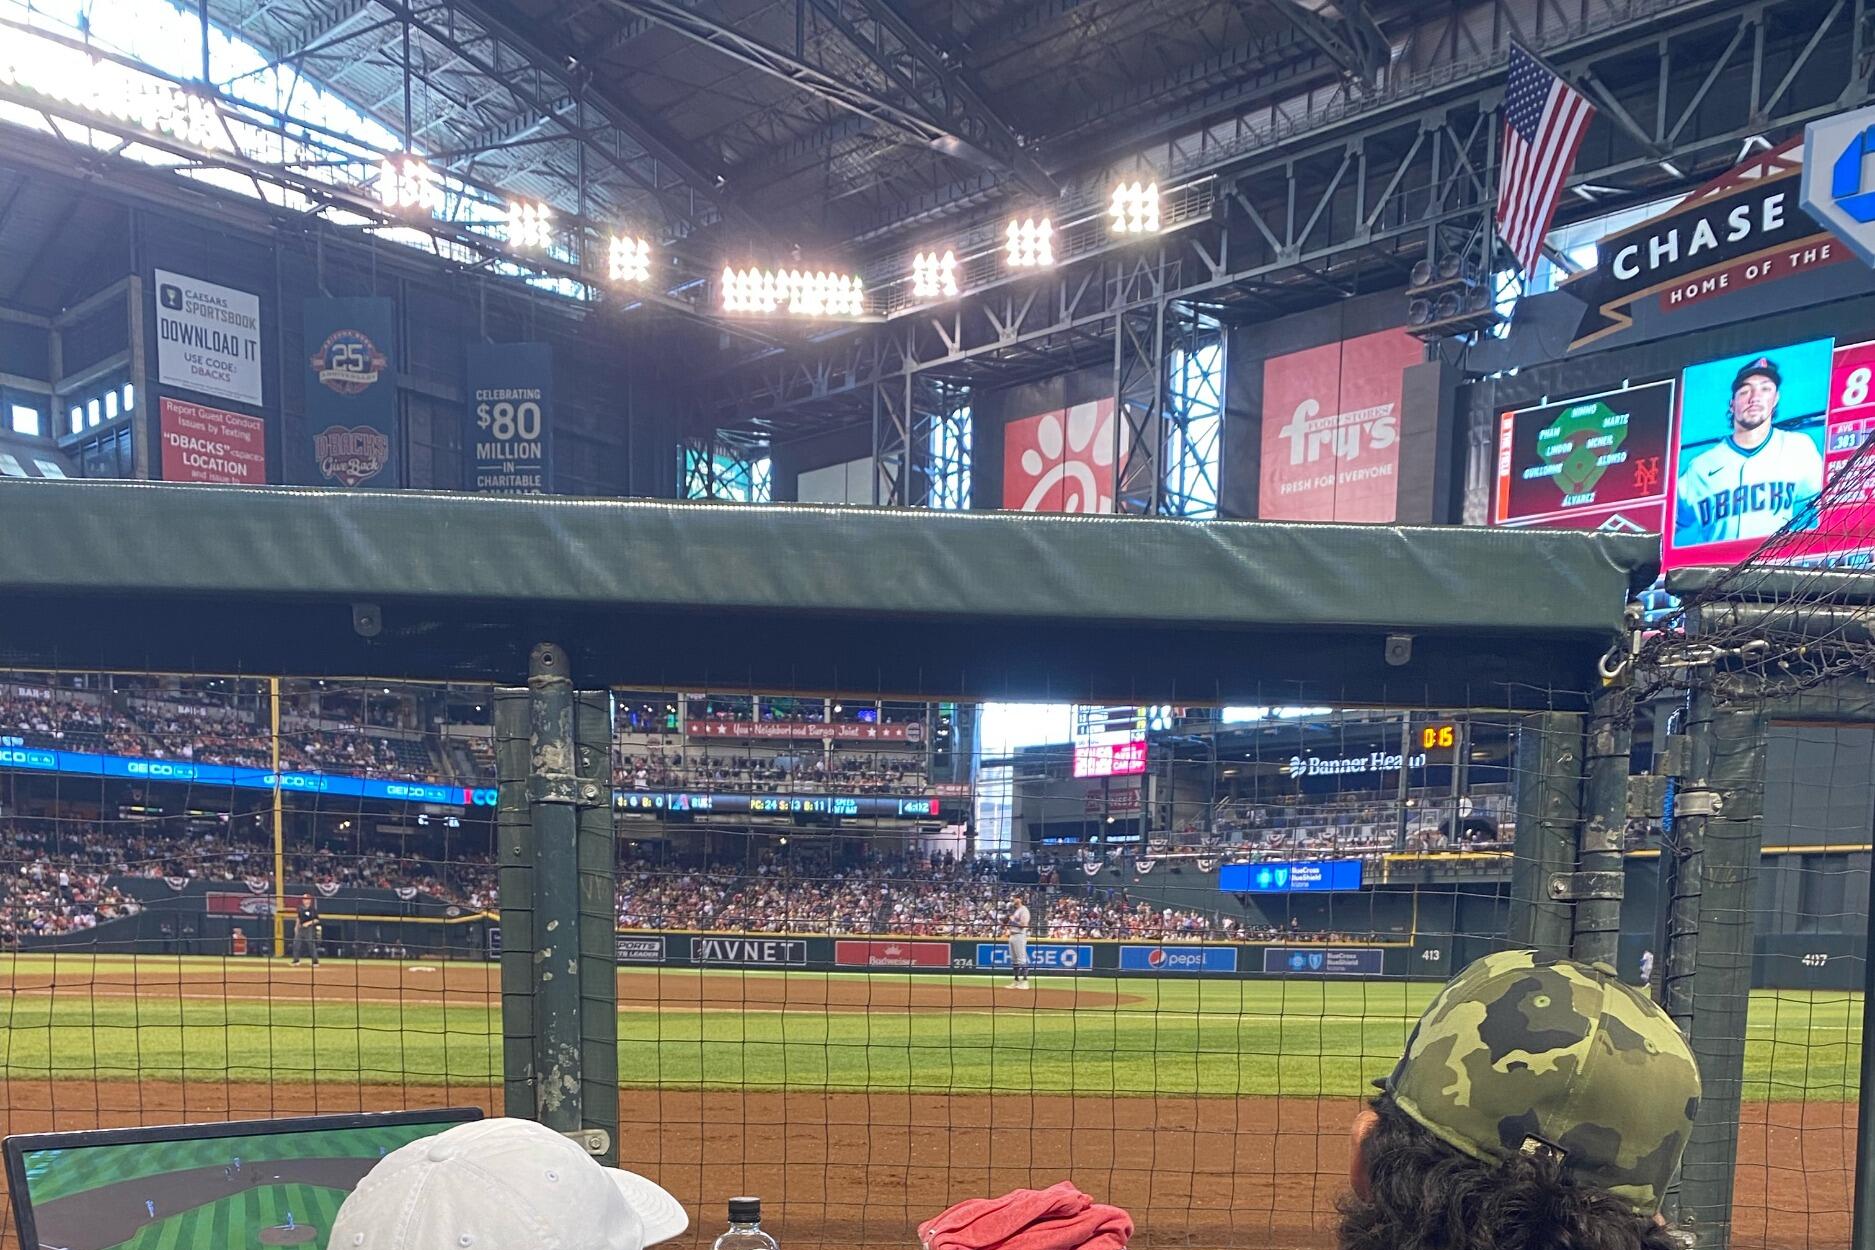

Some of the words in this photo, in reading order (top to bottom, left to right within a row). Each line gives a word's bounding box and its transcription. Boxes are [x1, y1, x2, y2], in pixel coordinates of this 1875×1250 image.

[1613, 193, 1784, 280] CHASE
[1671, 274, 1728, 304] HOME
[1746, 261, 1772, 279] OF
[1790, 245, 1831, 267] THE
[185, 289, 227, 308] CAESARS
[185, 300, 257, 331] SPORTSBOOK
[161, 318, 239, 357] DOWNLOAD
[244, 339, 257, 361] IT
[184, 352, 203, 366] USE
[206, 358, 238, 374] CODE:
[191, 366, 231, 382] DBACKS
[476, 389, 541, 401] CELEBRATING
[1841, 367, 1872, 407] 8
[166, 401, 196, 416] Report
[198, 409, 223, 422] Guest
[225, 414, 261, 431] Conduct
[476, 402, 541, 440] $80
[208, 423, 218, 435] by
[221, 426, 251, 442] Texting
[1279, 399, 1397, 465] fry's
[476, 442, 541, 460] MILLION
[183, 452, 247, 476] LOCATION
[322, 457, 348, 477] Give
[346, 458, 378, 477] Back
[503, 462, 515, 473] IN
[477, 475, 542, 487] CHARITABLE
[1281, 479, 1311, 494] FRESH
[1315, 474, 1336, 486] FOR
[1340, 464, 1392, 484] EVERYONE
[1698, 482, 1795, 526] DBACKS
[18, 687, 51, 699] BAR-S
[839, 725, 859, 736] Joint
[1424, 726, 1454, 748] 0:15
[128, 762, 173, 776] GEICO
[1308, 757, 1367, 776] Banner
[387, 785, 425, 797] GEICO
[1168, 953, 1207, 966] pepsi
[1422, 950, 1440, 961] 413
